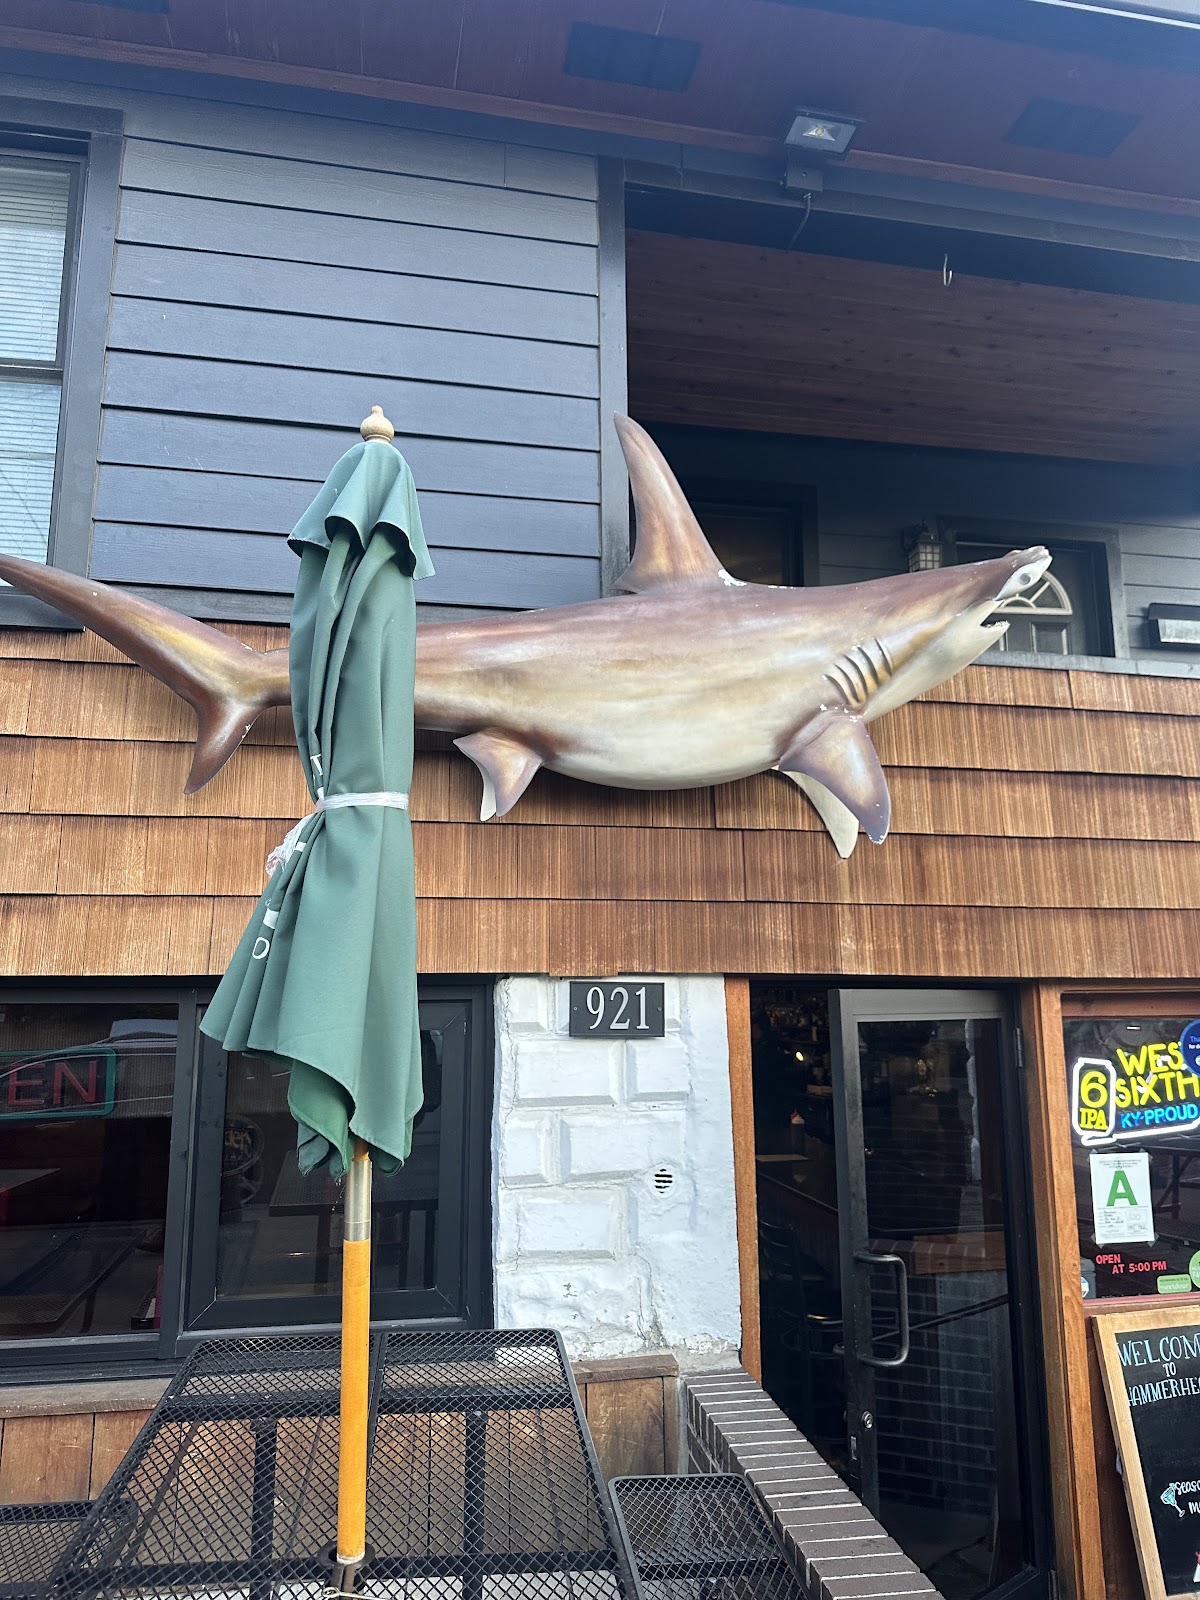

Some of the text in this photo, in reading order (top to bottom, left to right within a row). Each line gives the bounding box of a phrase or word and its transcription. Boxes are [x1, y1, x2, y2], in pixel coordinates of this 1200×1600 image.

[586, 986, 650, 1030] 921
[1116, 1041, 1184, 1076] WES
[8, 1060, 98, 1106] EN
[1080, 1070, 1108, 1108] 6
[1115, 1071, 1200, 1108] SIXTH
[1080, 1108, 1108, 1131] IPA
[1106, 1170, 1138, 1207] A
[1096, 1254, 1121, 1264] OPEN
[1112, 1261, 1167, 1275] AT 5:00 PM
[1162, 1361, 1177, 1378] TO
[1128, 1377, 1200, 1407] HAMMERHE
